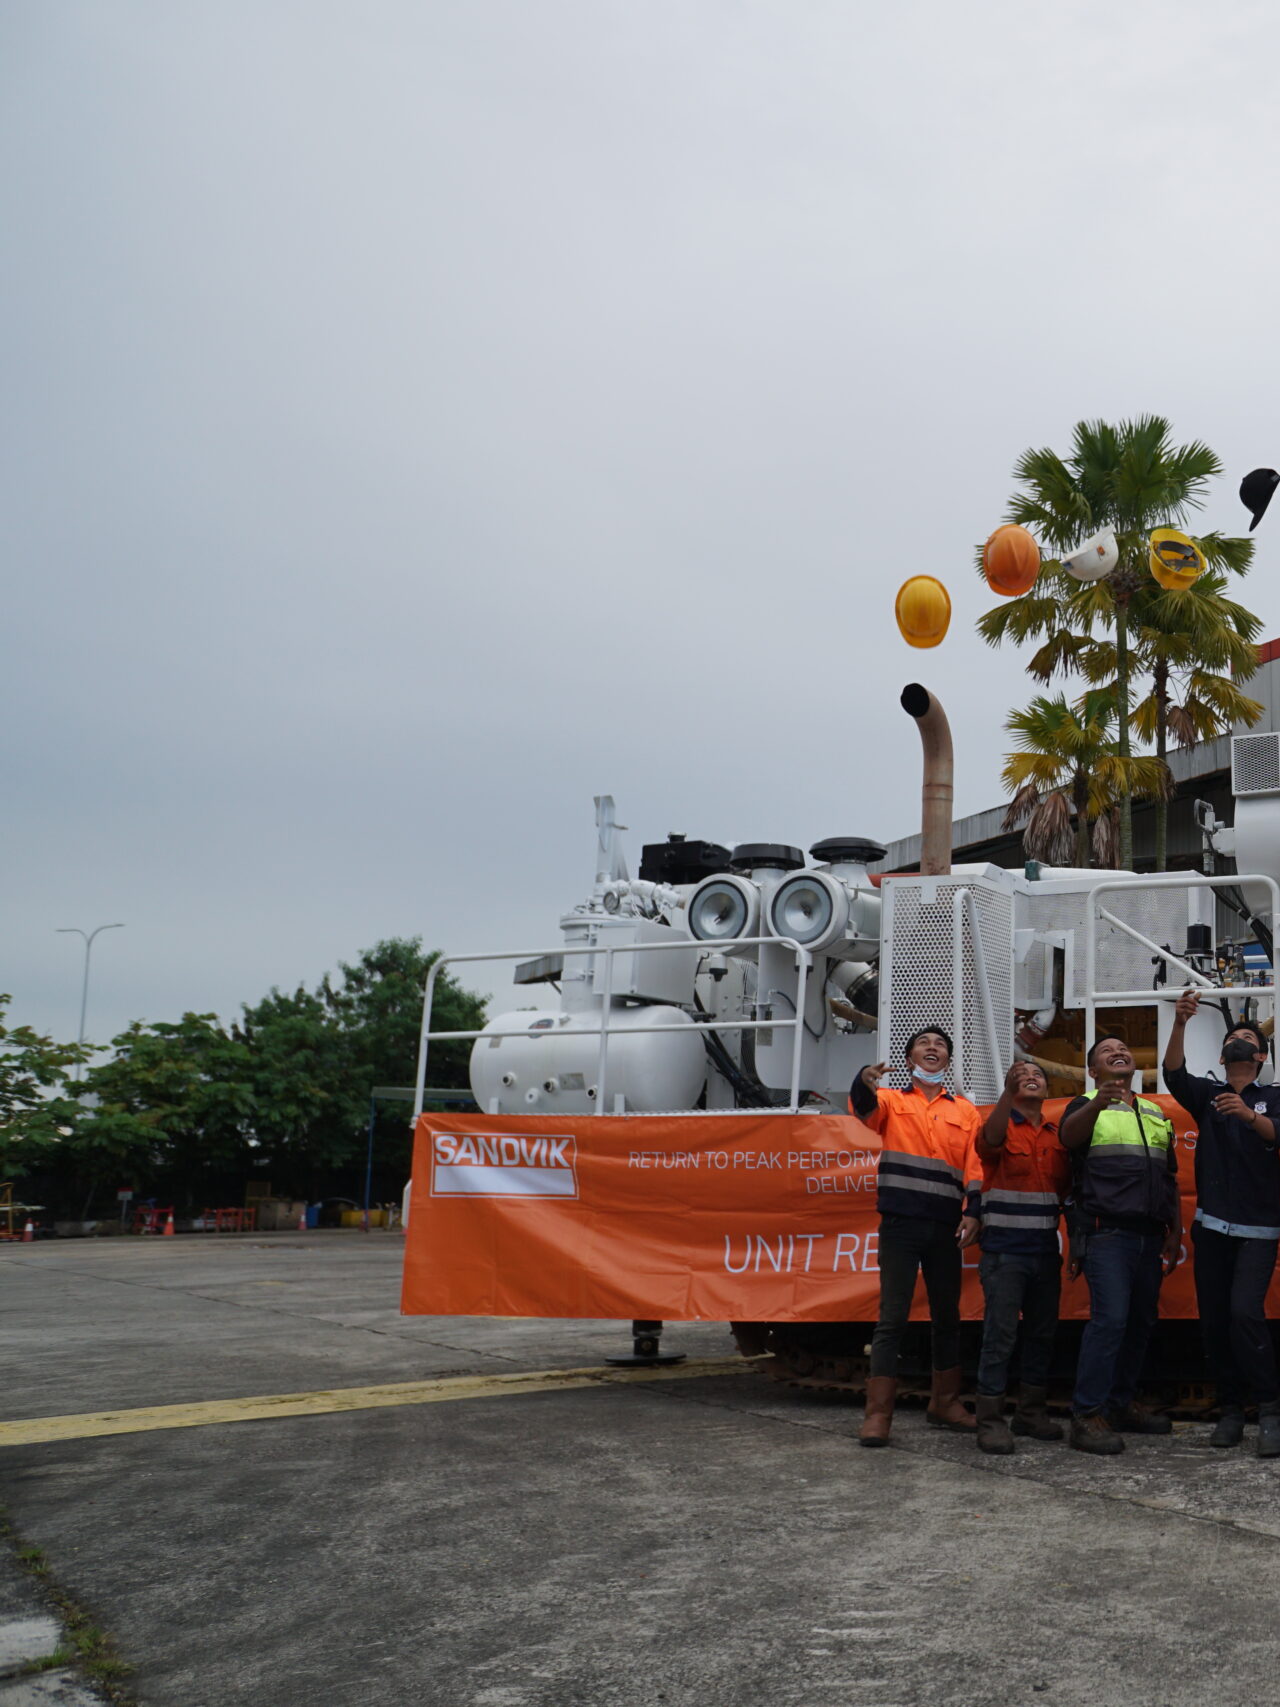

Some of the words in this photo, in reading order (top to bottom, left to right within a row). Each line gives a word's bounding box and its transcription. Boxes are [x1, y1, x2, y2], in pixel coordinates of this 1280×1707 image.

[435, 1135, 571, 1168] SANDVIK
[628, 1150, 699, 1169] RETURN
[704, 1151, 729, 1169] TO
[733, 1151, 782, 1169] PEAK
[724, 1234, 824, 1273] UNIT
